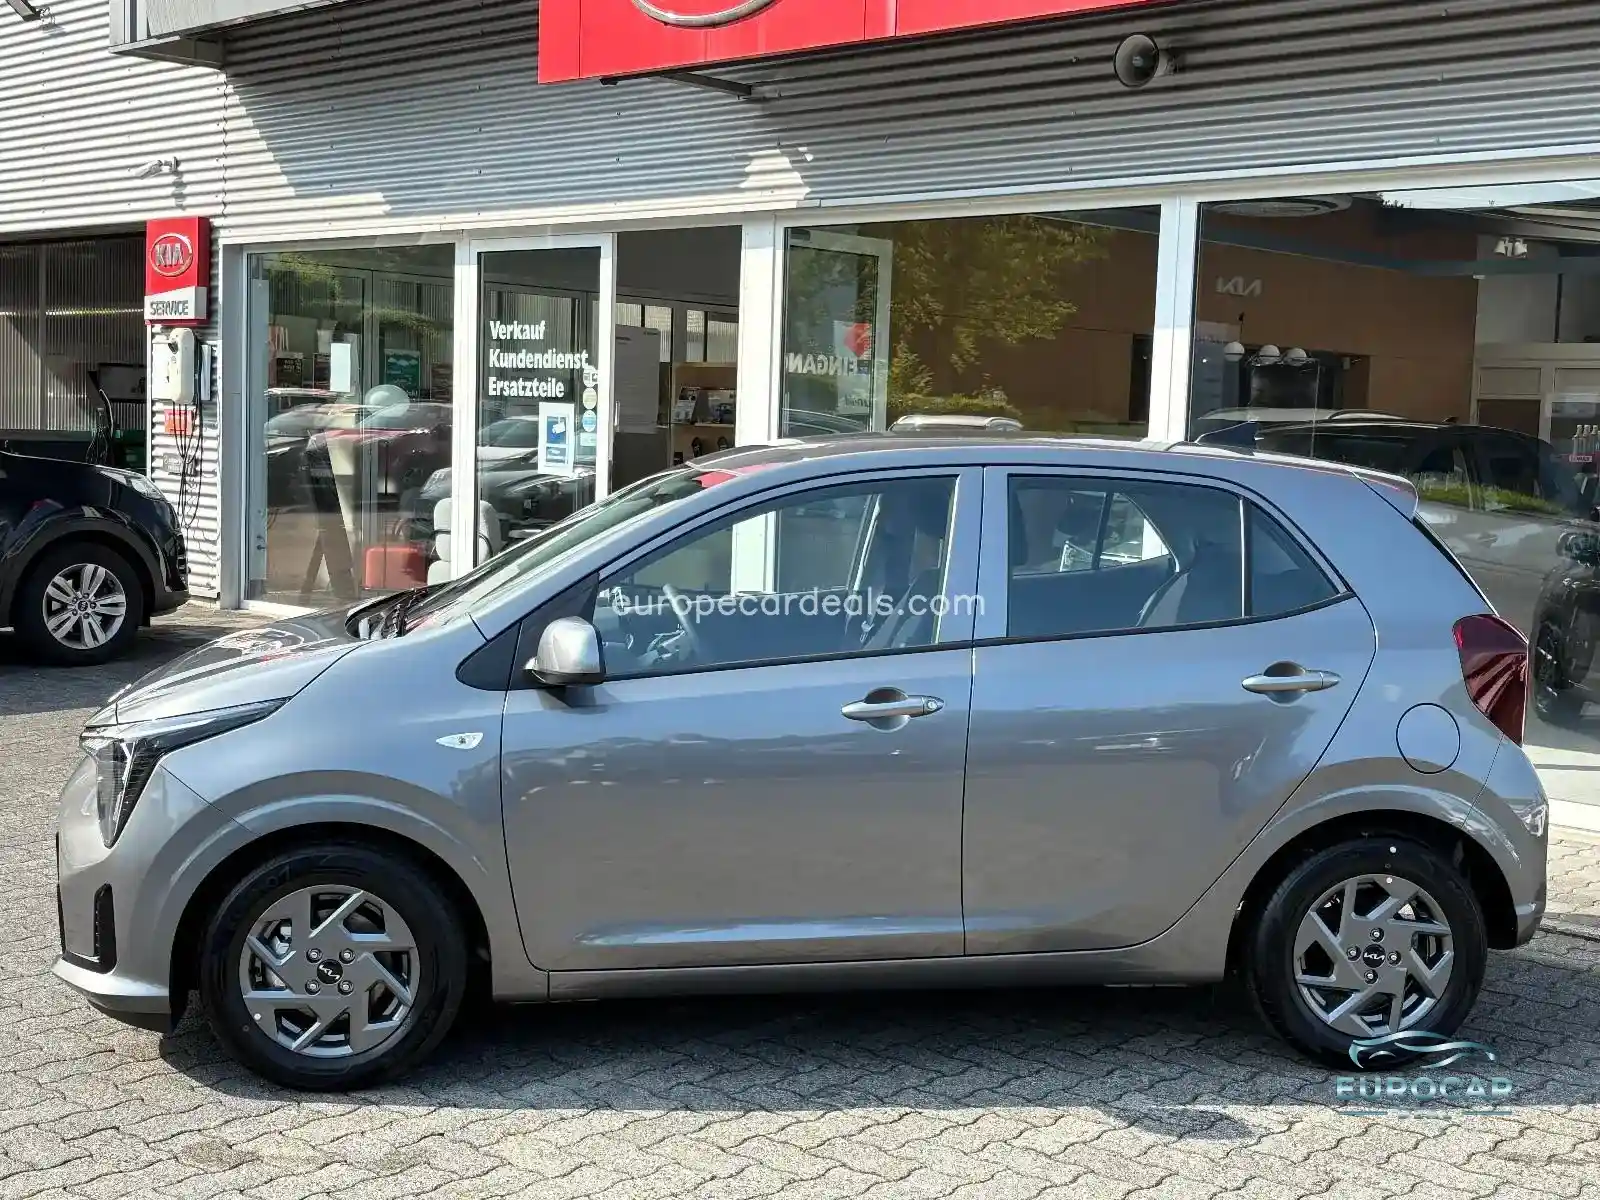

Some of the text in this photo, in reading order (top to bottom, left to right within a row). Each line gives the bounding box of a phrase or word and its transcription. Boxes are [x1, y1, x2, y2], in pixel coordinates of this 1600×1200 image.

[155, 243, 184, 267] KIA
[150, 299, 189, 316] SERVICE
[489, 320, 546, 340] Verkauf
[489, 348, 589, 369] Kundendienst
[488, 377, 565, 398] Ersatzteile
